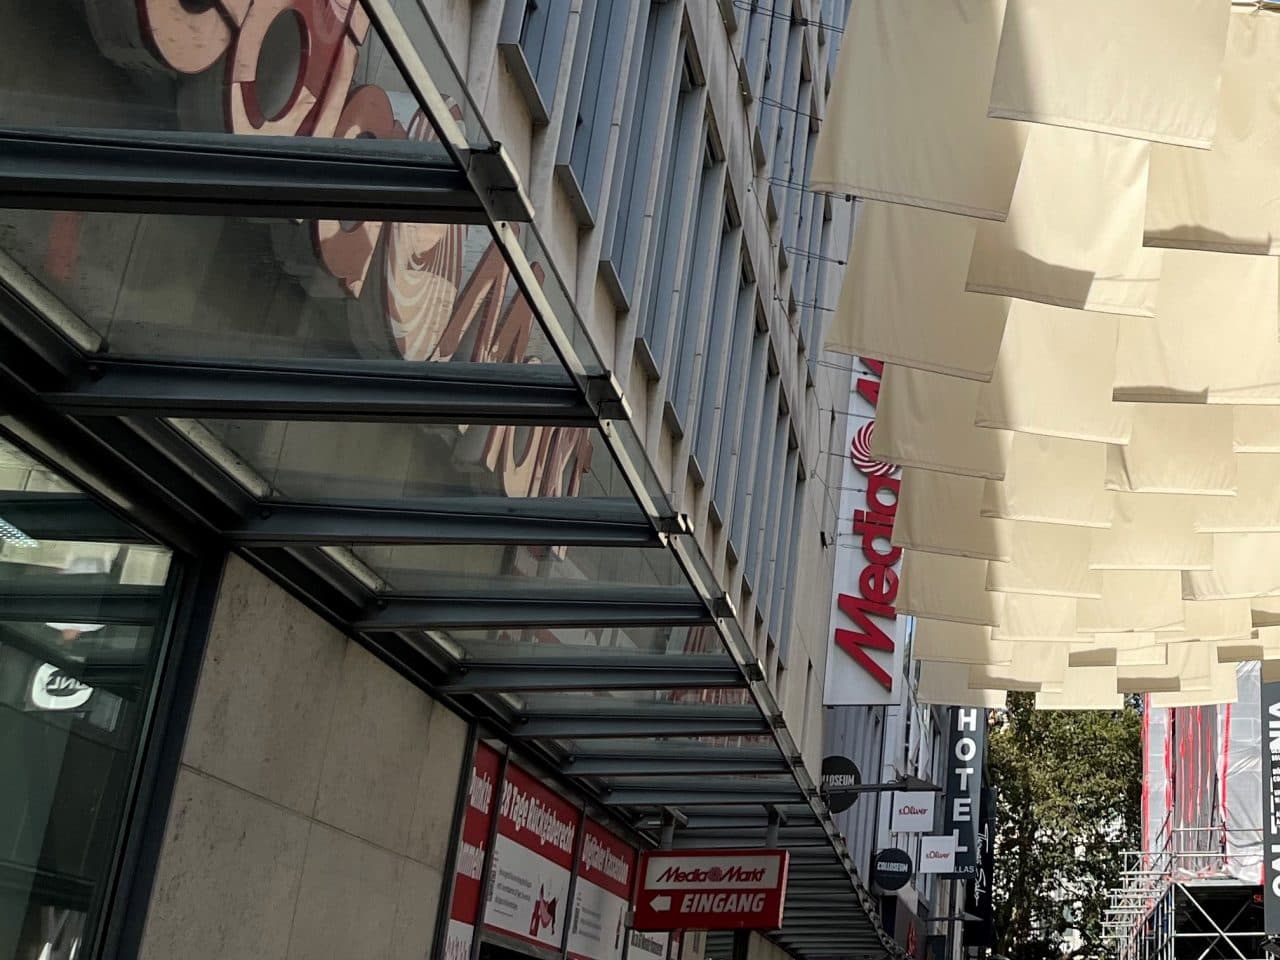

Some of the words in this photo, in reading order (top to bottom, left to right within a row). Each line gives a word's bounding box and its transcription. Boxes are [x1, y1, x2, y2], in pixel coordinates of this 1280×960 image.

[834, 475, 904, 693] Media
[952, 708, 977, 853] HOTEL
[509, 786, 529, 832] Tage
[656, 866, 708, 882] Media
[721, 866, 767, 882] Markt
[680, 893, 767, 913] EINGANG
